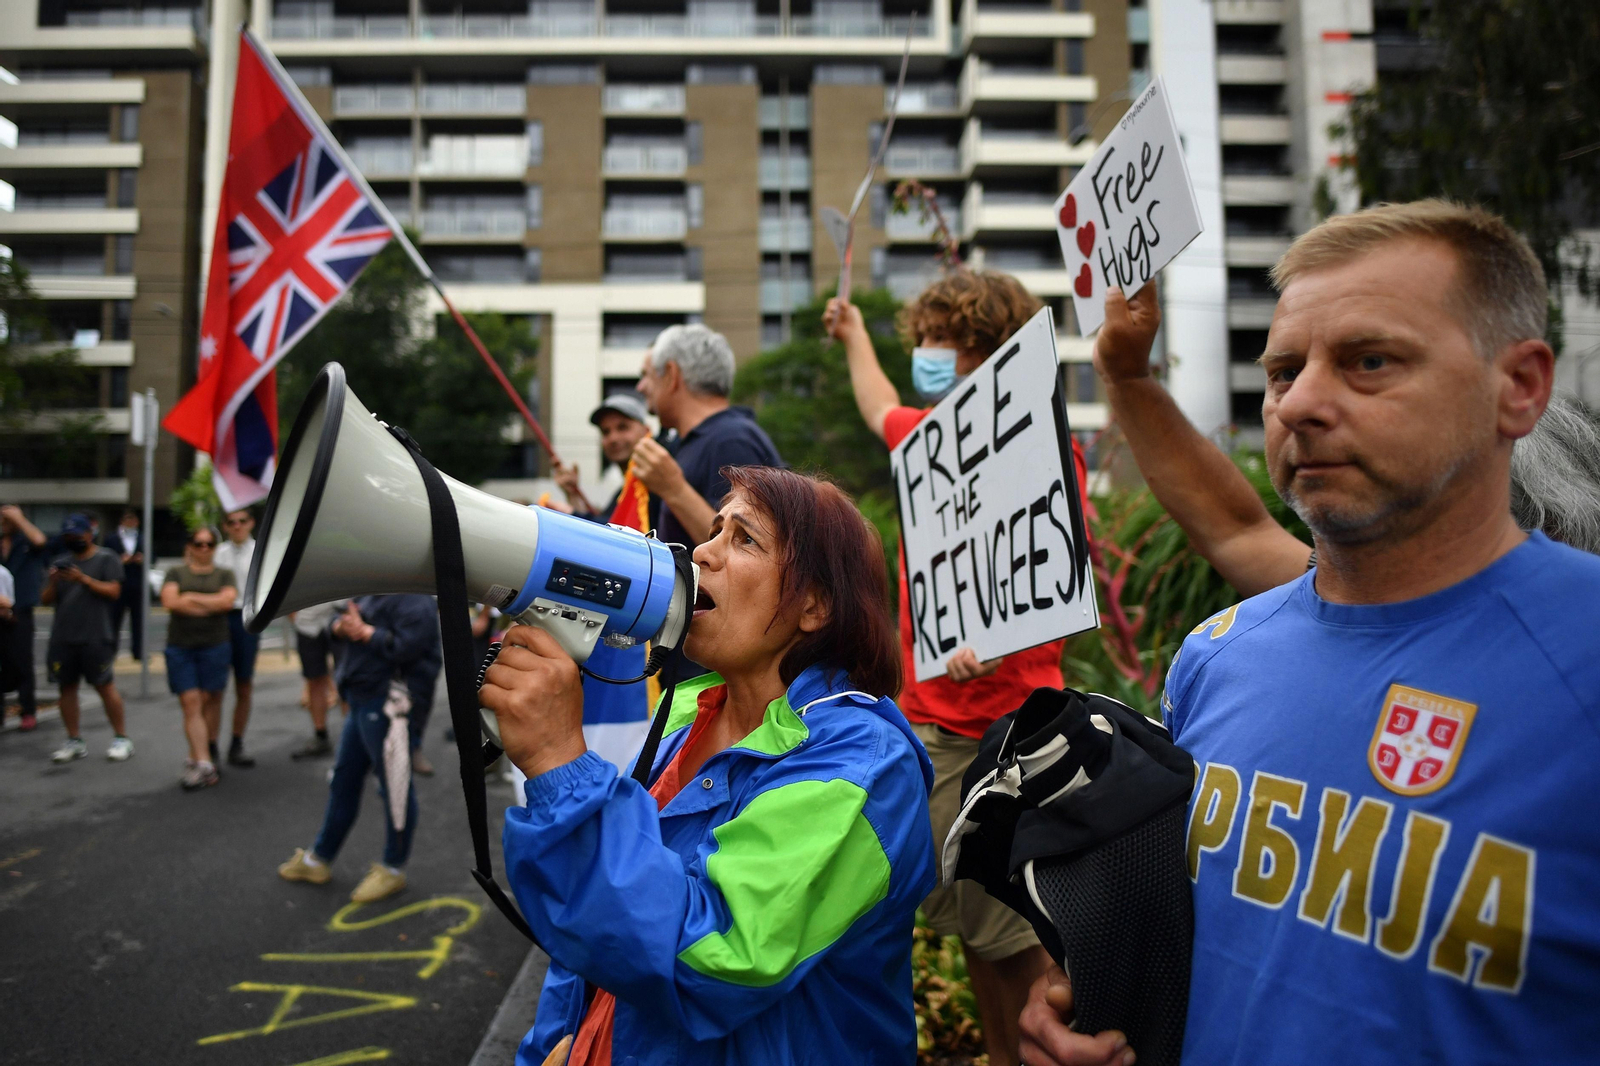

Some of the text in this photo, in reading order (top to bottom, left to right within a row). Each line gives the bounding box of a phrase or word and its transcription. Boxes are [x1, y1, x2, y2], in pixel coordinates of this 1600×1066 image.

[1091, 141, 1164, 230] Free
[1098, 199, 1161, 297] Hugs
[902, 343, 1033, 527] FREE
[935, 472, 982, 537] THE
[912, 479, 1076, 664] REFUGEES
[1186, 759, 1537, 995] РБИЈА
[196, 896, 482, 1066] STA
